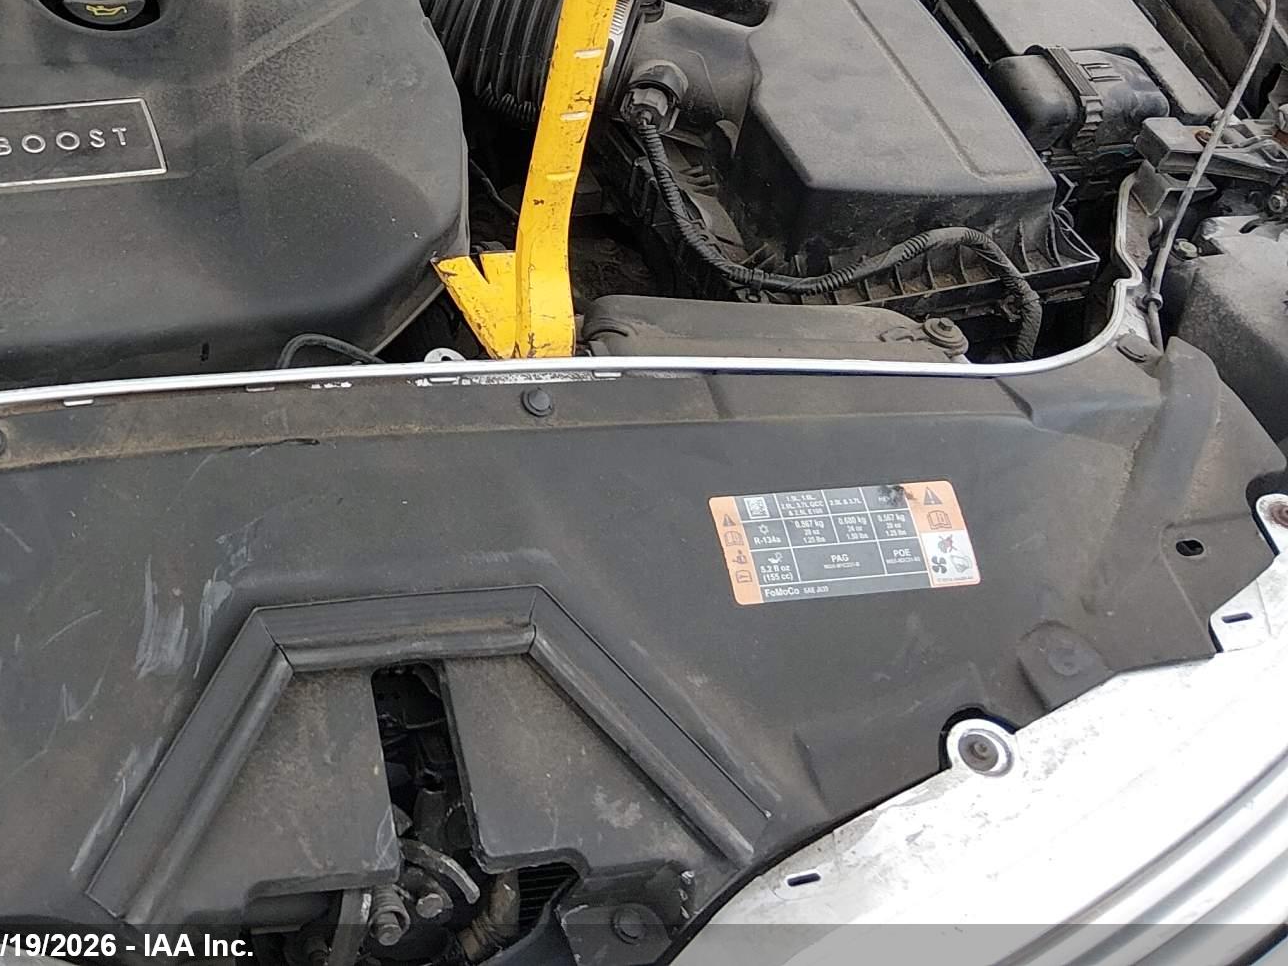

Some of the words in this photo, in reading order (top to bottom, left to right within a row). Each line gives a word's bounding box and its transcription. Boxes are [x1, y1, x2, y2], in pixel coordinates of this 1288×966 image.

[857, 515, 868, 525] kg
[896, 513, 907, 523] kg
[814, 519, 825, 529] kg
[754, 535, 782, 545] R-134a
[893, 548, 913, 557] POE
[831, 554, 850, 563] PAG
[763, 573, 781, 583] (155
[781, 572, 795, 582] cc)
[764, 586, 801, 597] FoMoCo
